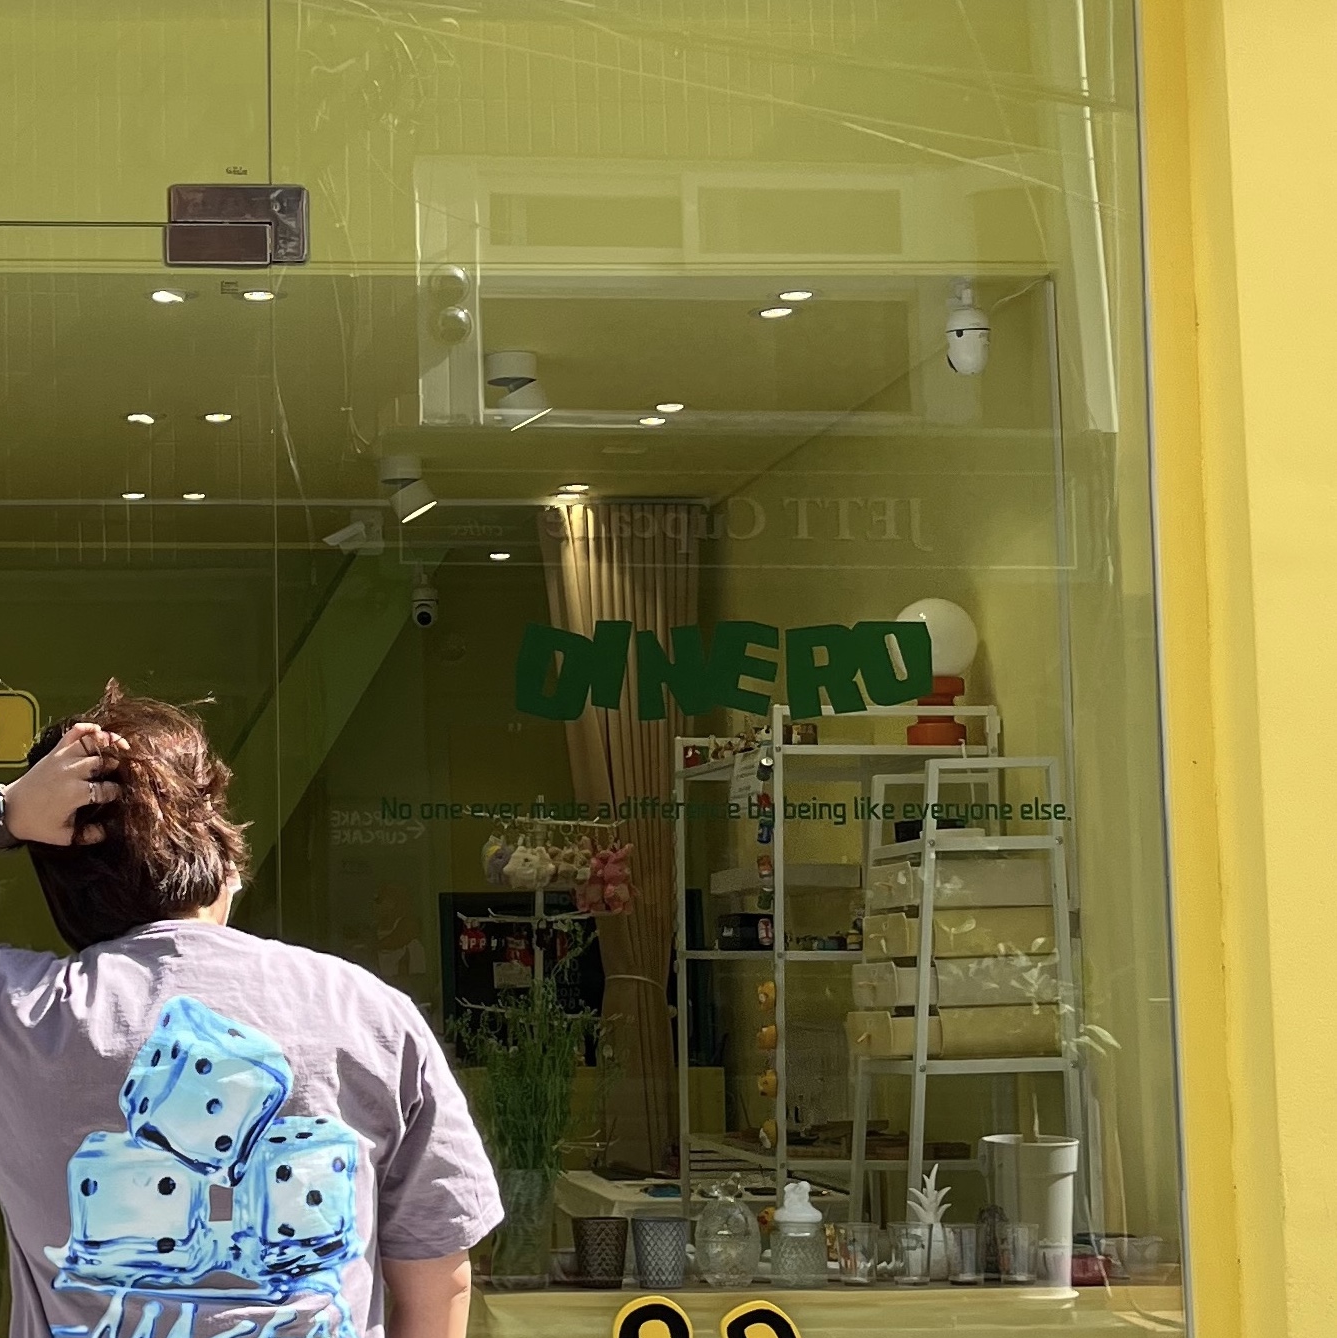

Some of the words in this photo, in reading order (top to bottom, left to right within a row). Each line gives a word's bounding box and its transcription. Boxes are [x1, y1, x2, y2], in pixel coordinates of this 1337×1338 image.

[516, 620, 933, 721] DINERO
[382, 796, 412, 821] No
[421, 801, 463, 820] one
[470, 801, 522, 820] ever
[531, 796, 590, 820] made
[598, 801, 610, 820] a
[748, 797, 776, 825] by
[784, 797, 847, 824] being
[853, 796, 895, 820] like
[902, 802, 1013, 824] everyone
[1020, 797, 1072, 821] else.
